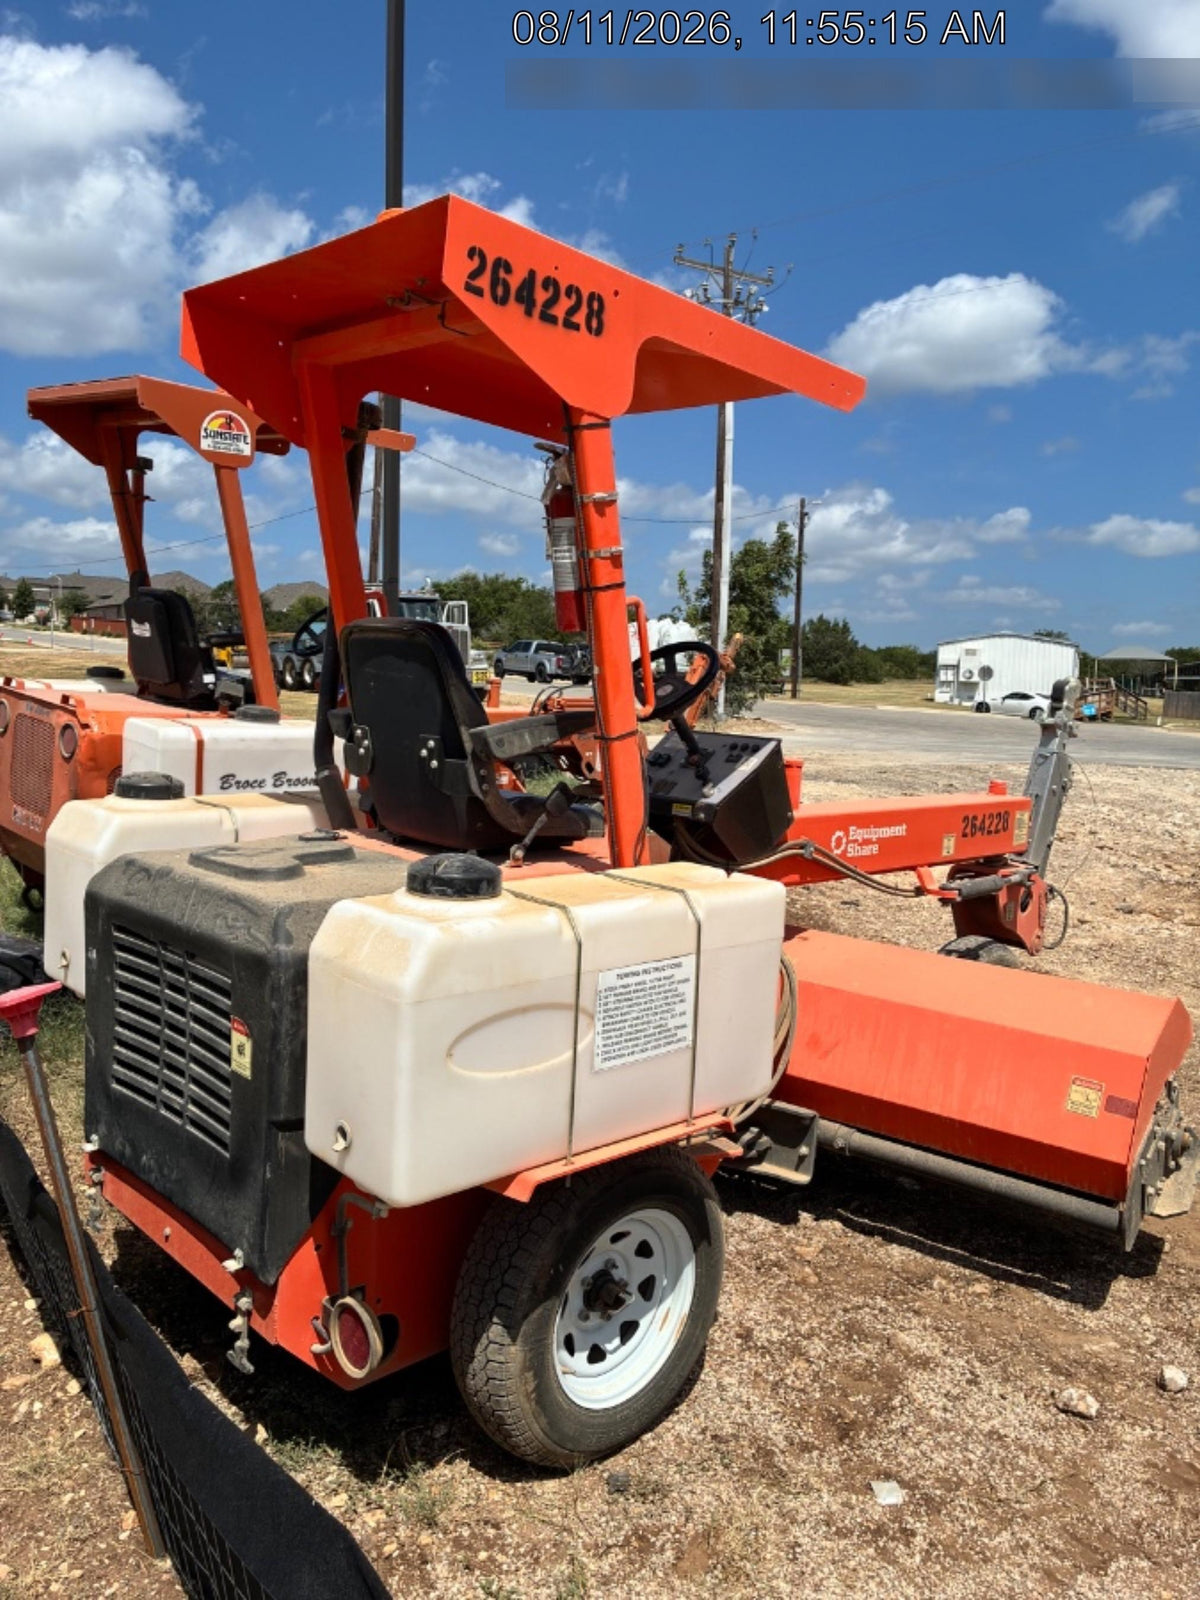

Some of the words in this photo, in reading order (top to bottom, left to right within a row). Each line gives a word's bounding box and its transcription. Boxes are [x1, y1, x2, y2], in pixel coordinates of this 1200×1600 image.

[463, 245, 605, 337] 264228
[219, 773, 267, 790] Broce
[848, 823, 907, 842] Equipment
[961, 810, 1010, 838] 264228
[846, 842, 880, 858] Share
